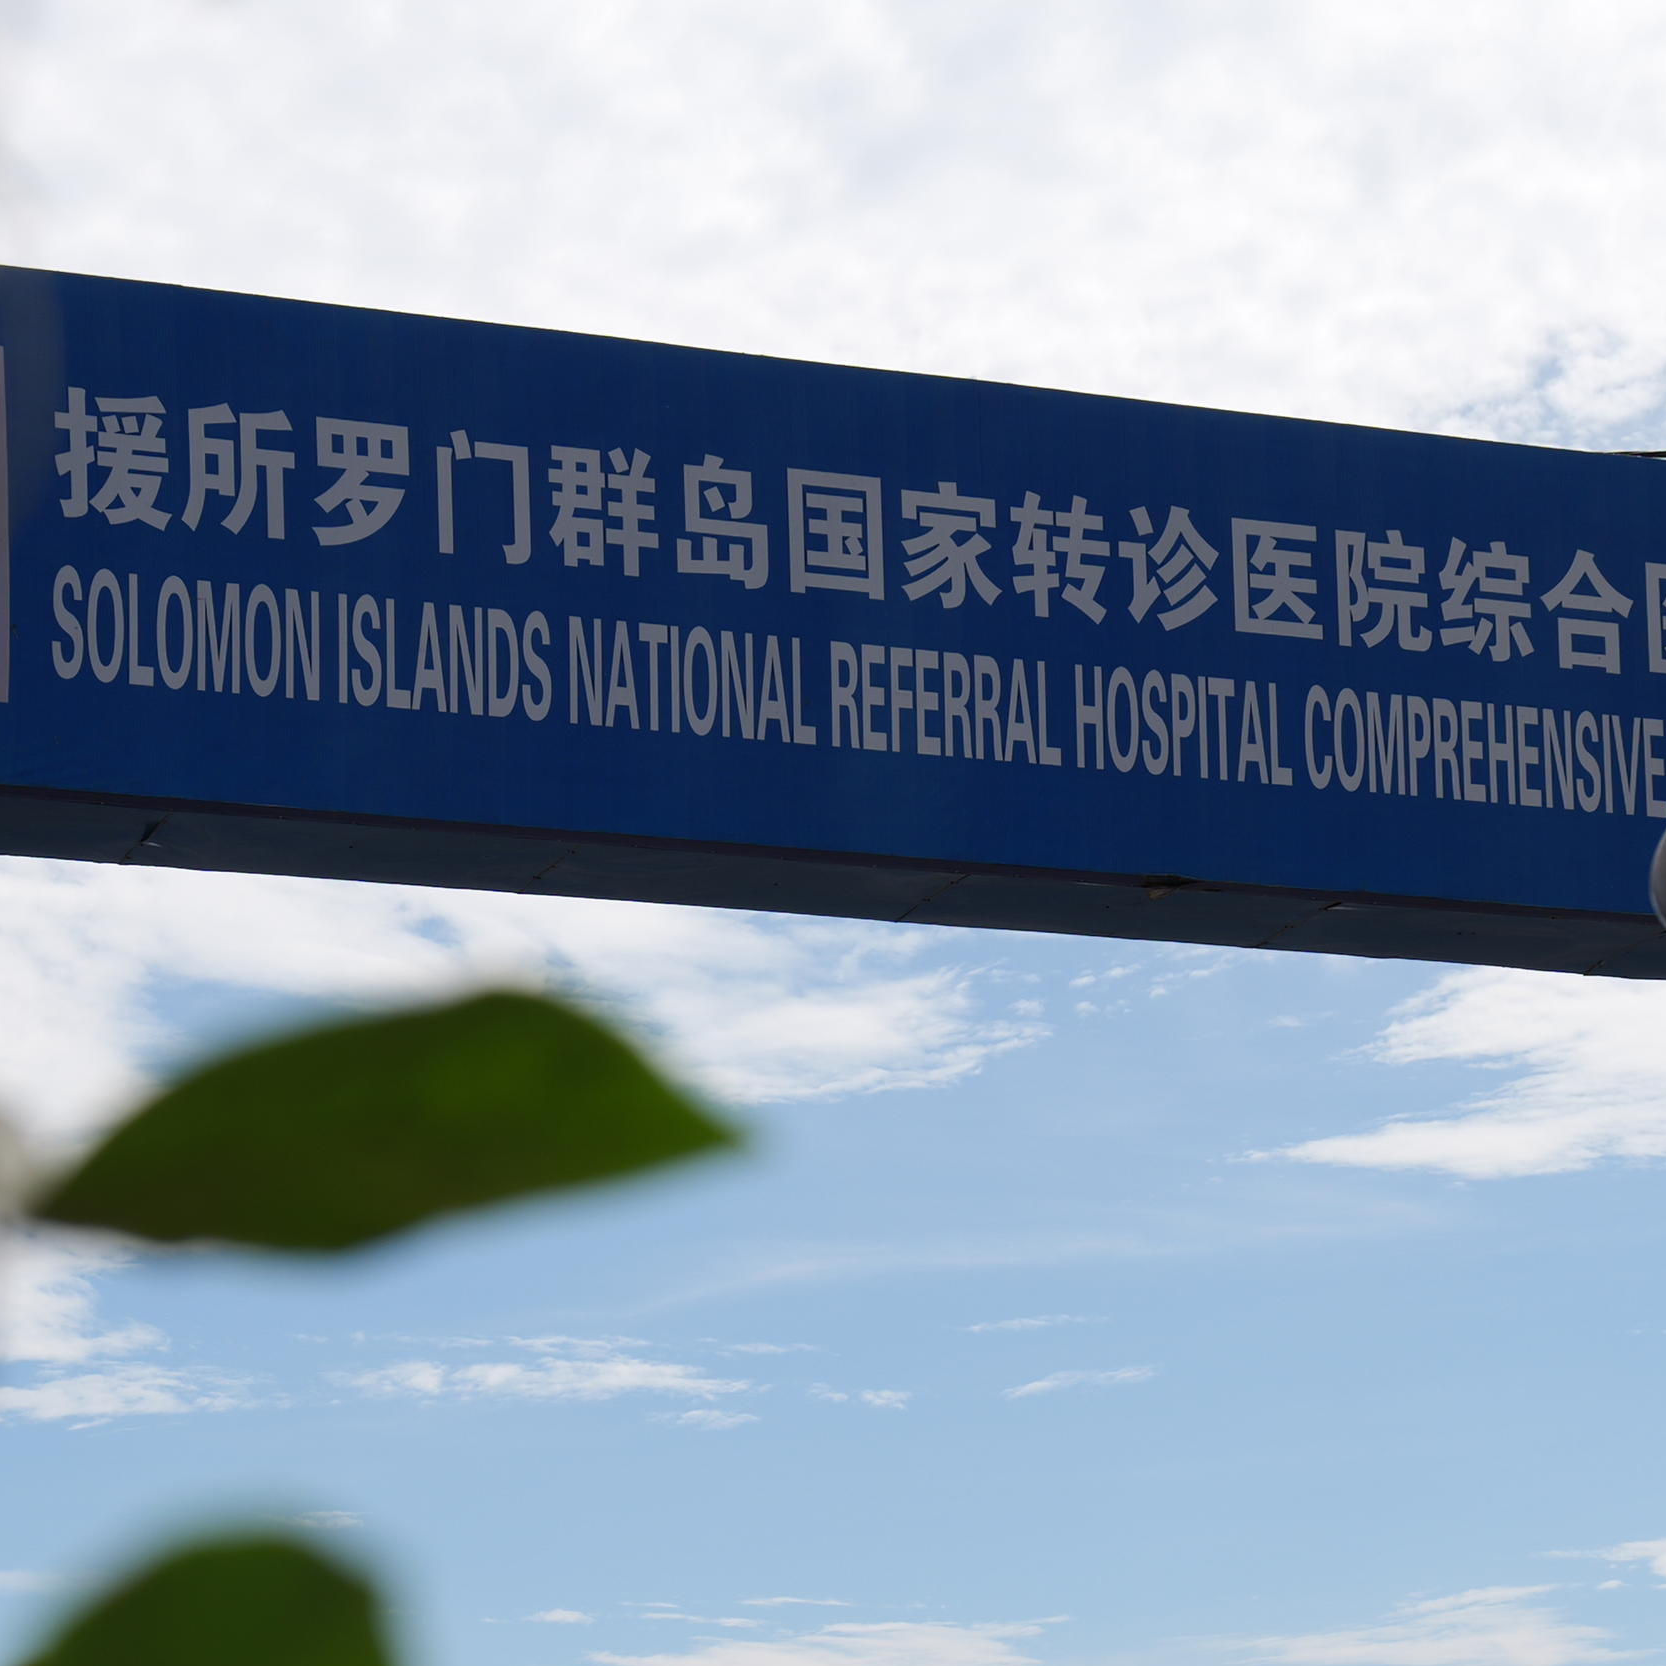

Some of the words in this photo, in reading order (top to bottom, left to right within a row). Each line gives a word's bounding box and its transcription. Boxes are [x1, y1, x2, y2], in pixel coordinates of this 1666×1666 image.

[51, 564, 320, 702] SOLOMON
[337, 593, 552, 722] ISLANDS
[568, 615, 817, 745] NATIONAL
[830, 640, 1062, 767] REFERRAL
[1074, 663, 1293, 787] HOSPITAL
